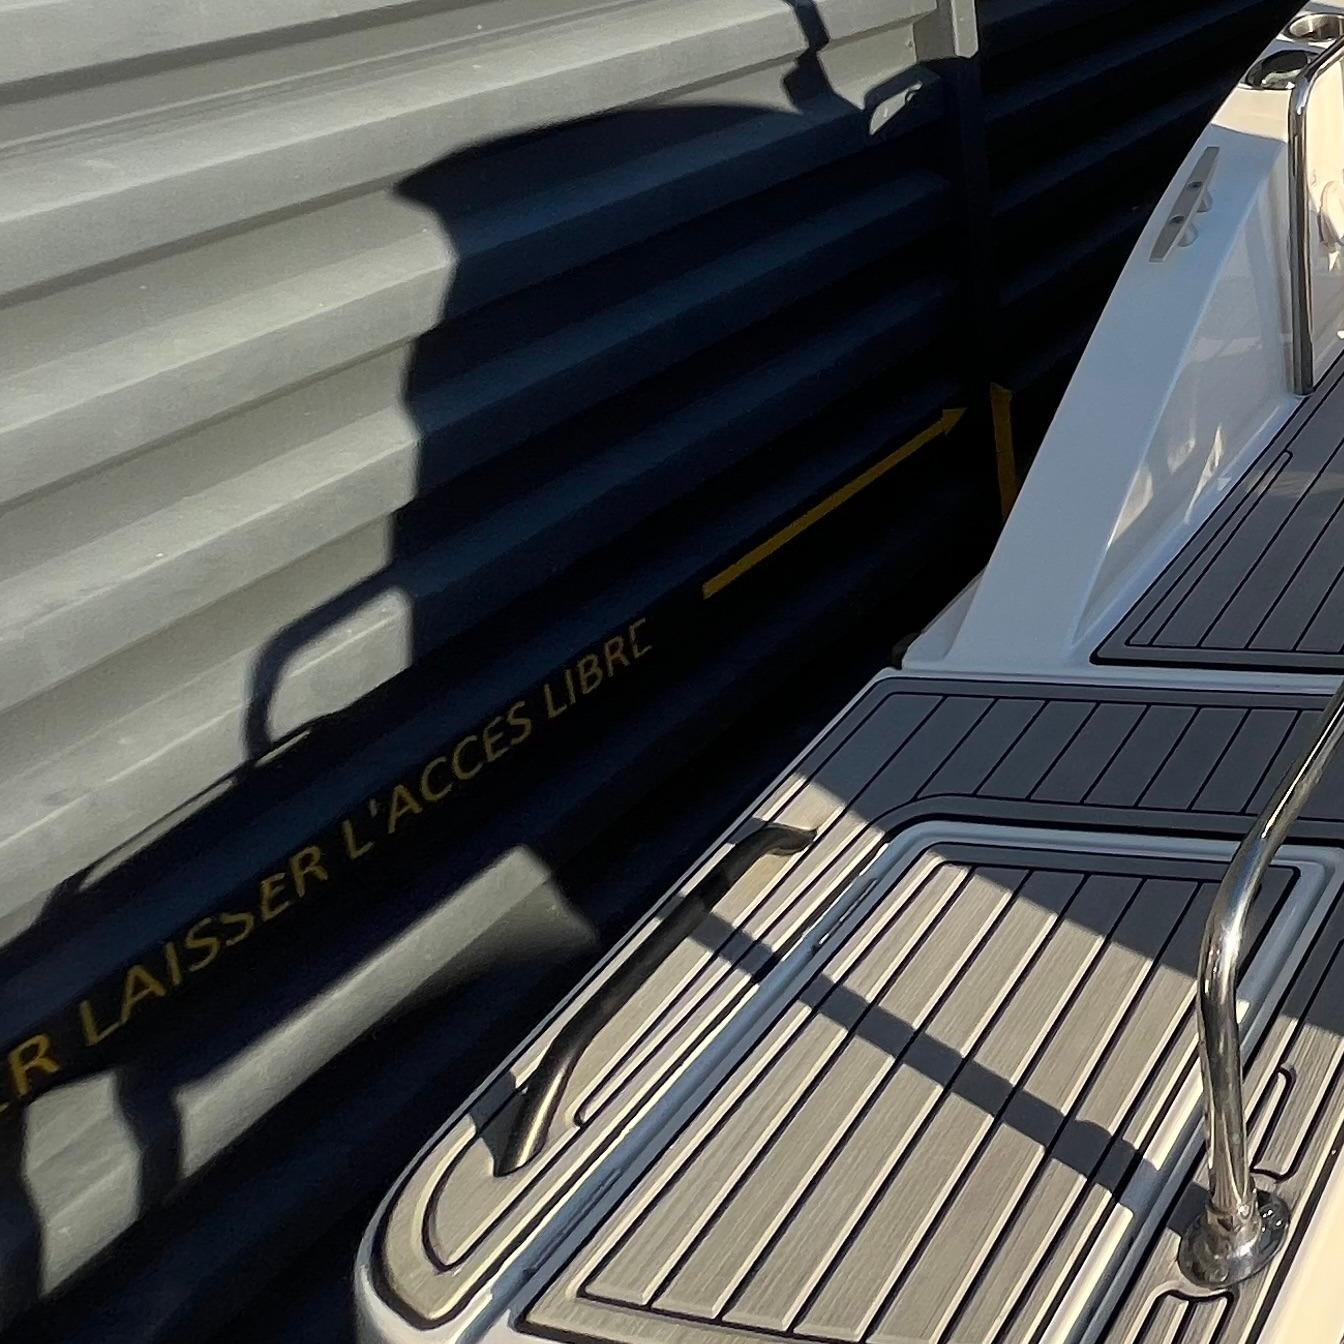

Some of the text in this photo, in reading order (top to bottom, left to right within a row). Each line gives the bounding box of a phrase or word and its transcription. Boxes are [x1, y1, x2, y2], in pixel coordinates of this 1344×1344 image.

[0, 617, 654, 1113] R LAISSER L'ACCES LIBRE
